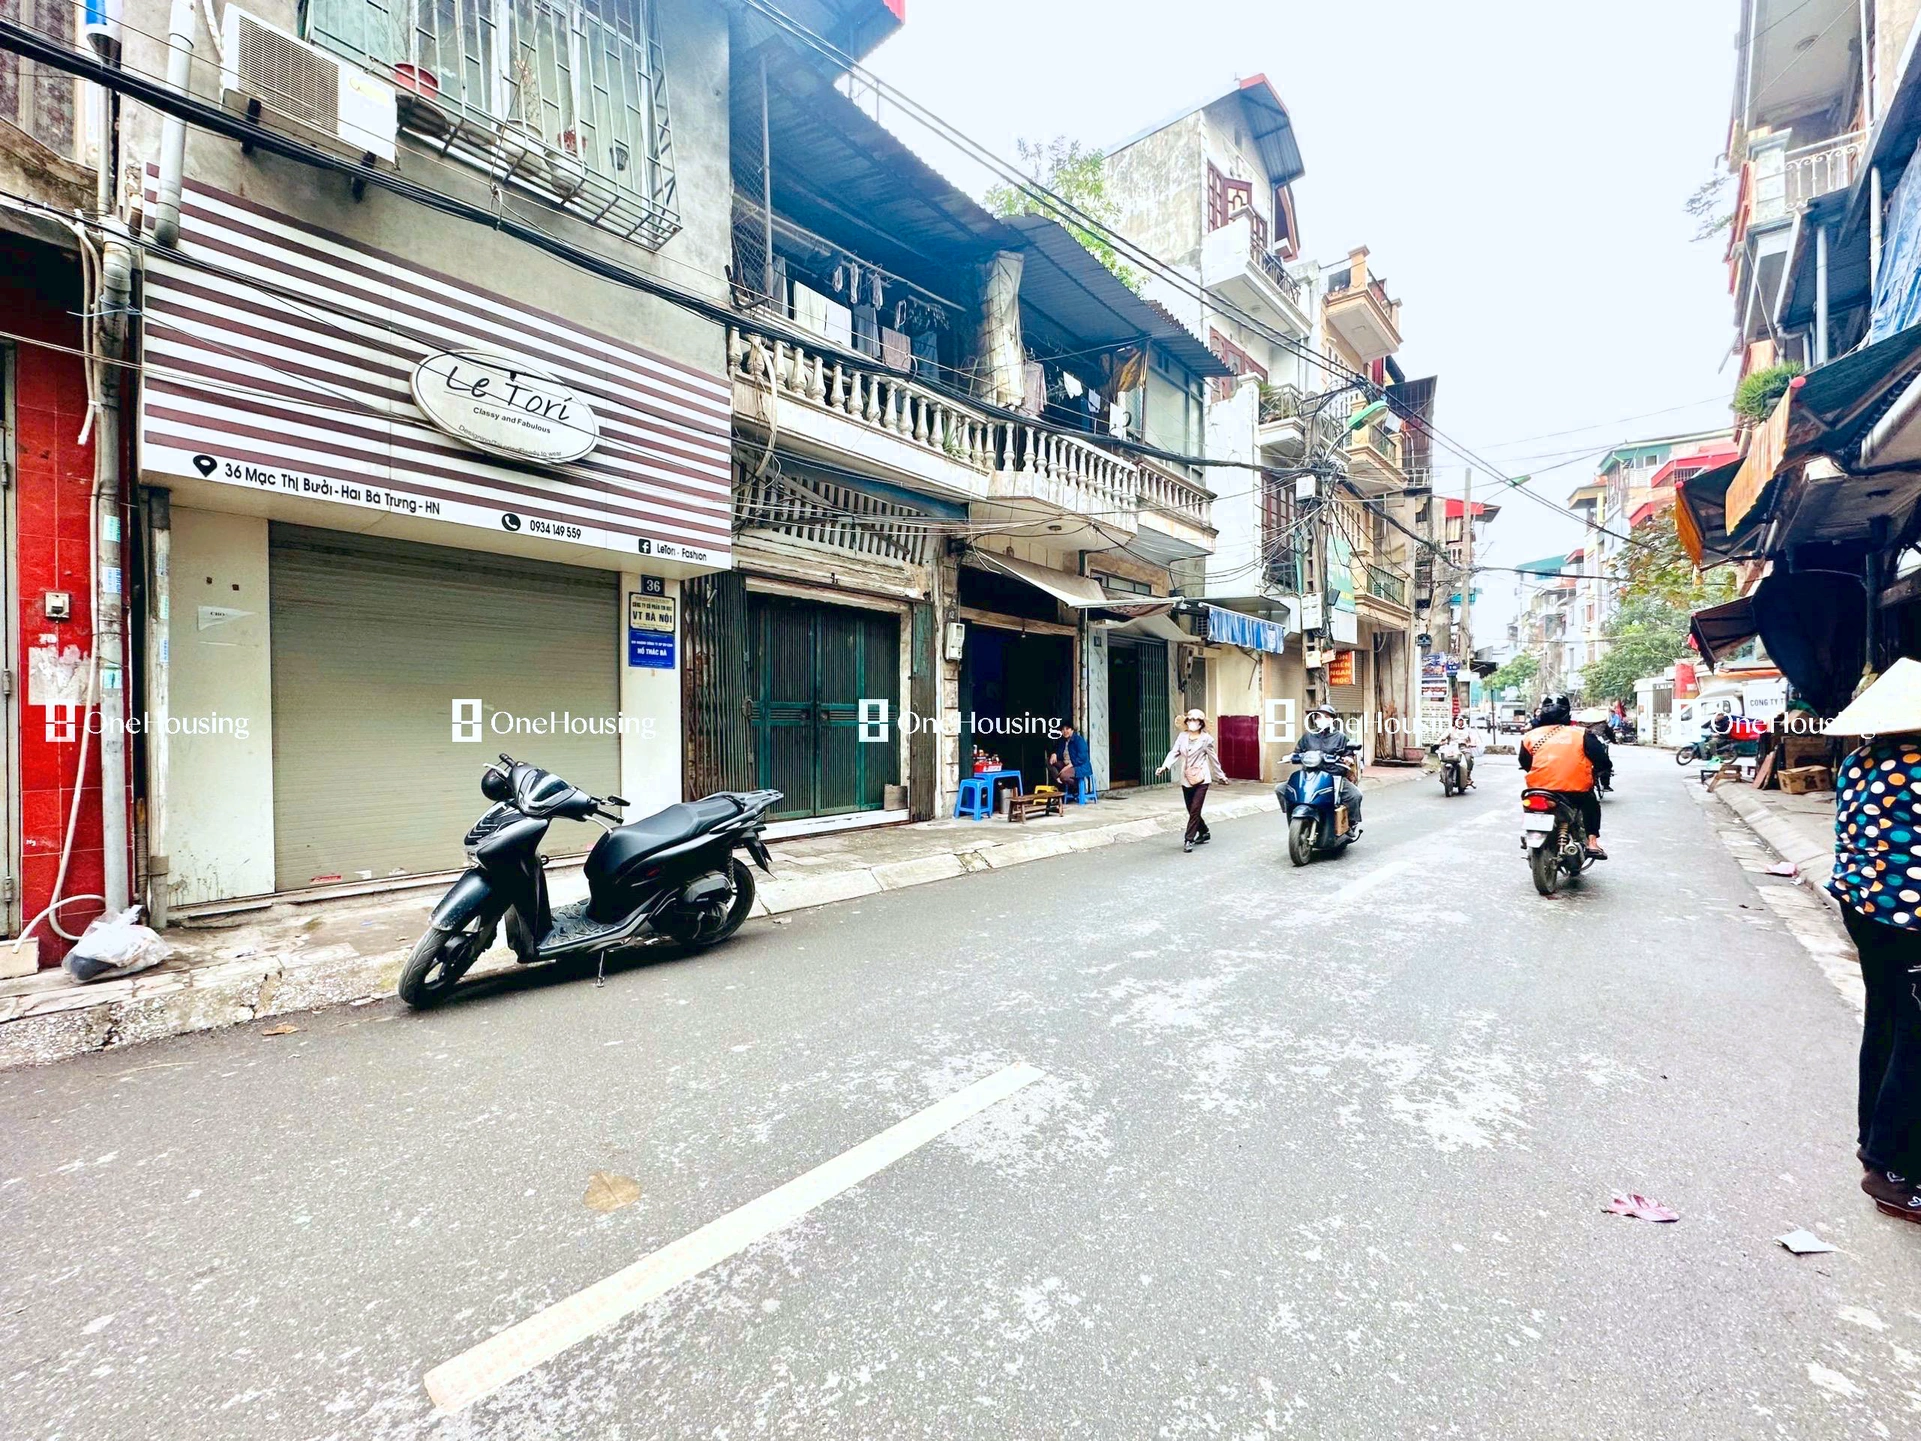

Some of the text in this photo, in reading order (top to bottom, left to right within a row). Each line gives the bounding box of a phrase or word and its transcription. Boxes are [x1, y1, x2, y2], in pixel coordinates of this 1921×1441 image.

[446, 366, 573, 420] Le Tori
[473, 406, 551, 434] Classy and Fabulous
[225, 463, 242, 479] 36
[245, 466, 276, 486] Mạc
[281, 473, 299, 492] Thị
[303, 477, 332, 496] Bưởi
[385, 493, 417, 513] Trưng
[425, 500, 440, 515] HN
[530, 519, 581, 540] 0934 149 559
[682, 547, 707, 562] Fashion
[646, 579, 661, 592] 36
[632, 611, 643, 620] VT
